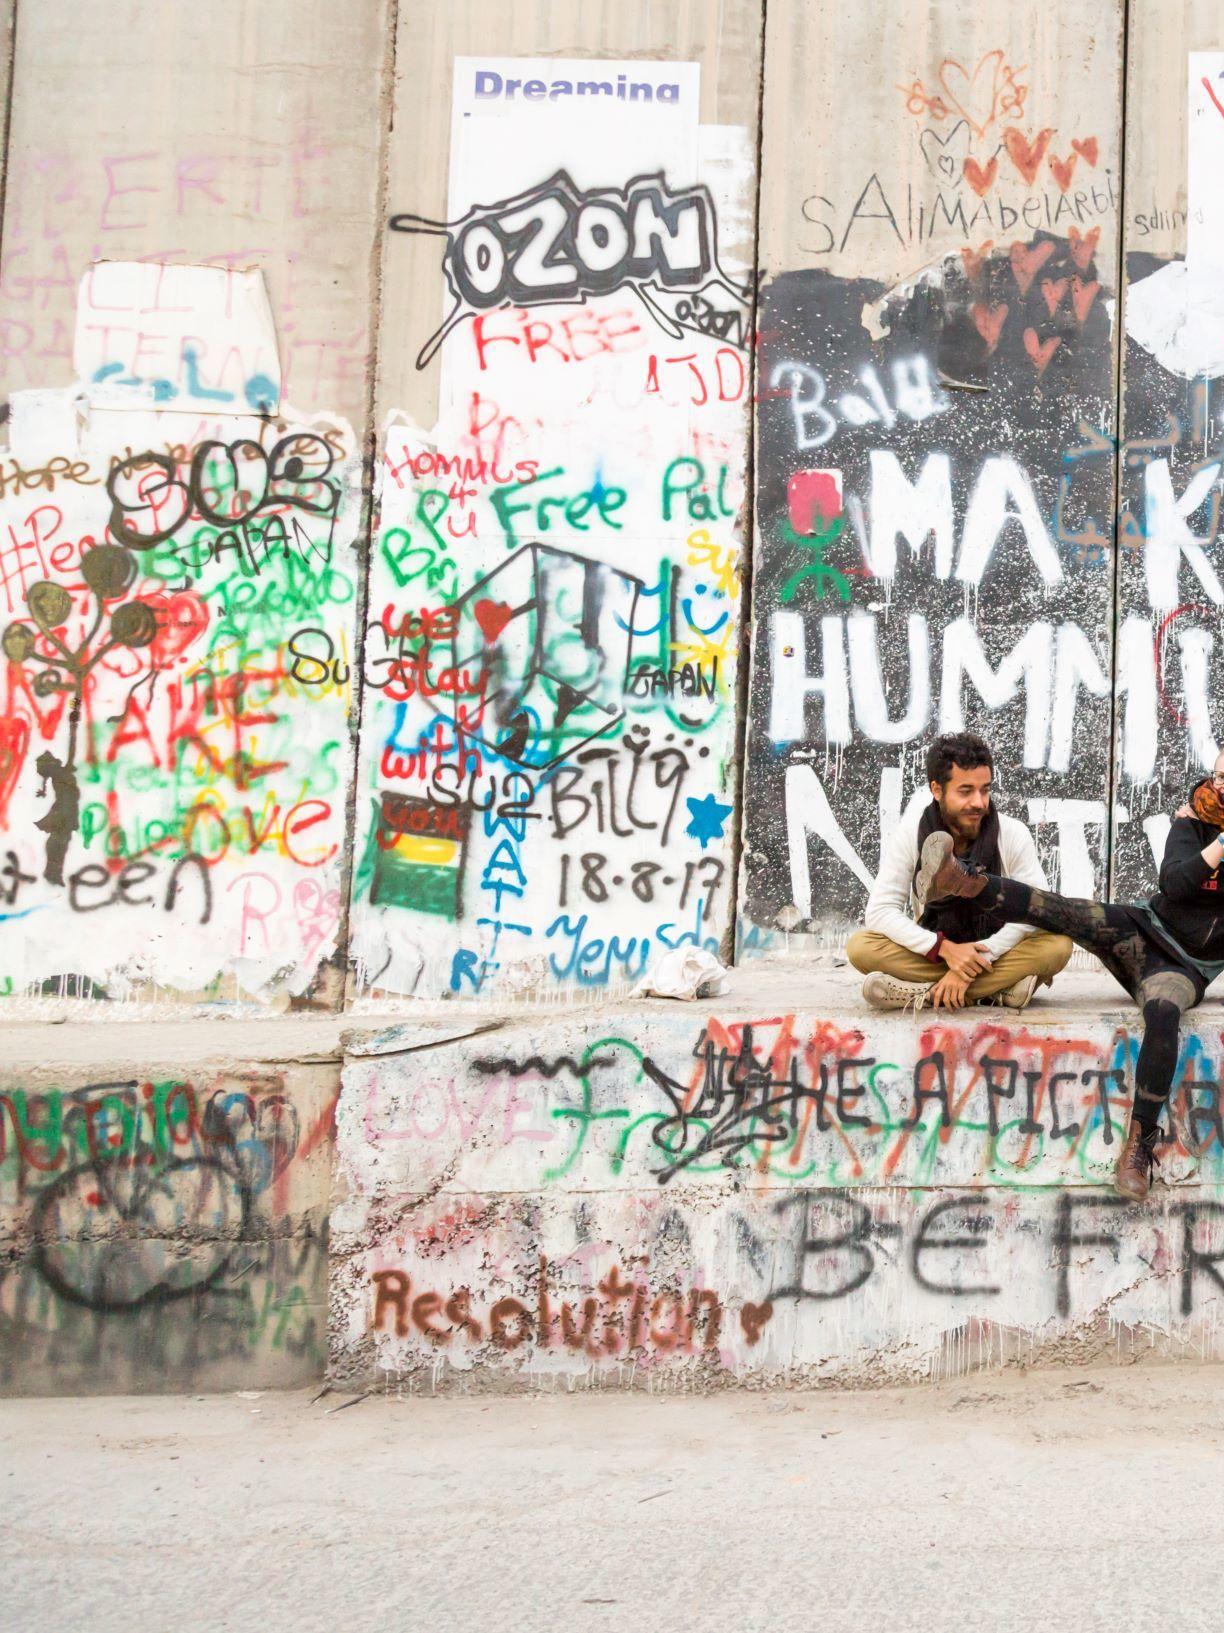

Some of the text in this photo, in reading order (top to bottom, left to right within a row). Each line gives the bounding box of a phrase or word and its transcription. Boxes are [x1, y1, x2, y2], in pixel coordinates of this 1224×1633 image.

[473, 70, 681, 105] Dreaming
[472, 305, 649, 370] FREE
[488, 456, 736, 549] Free Pal
[365, 1070, 556, 1146] LOVE
